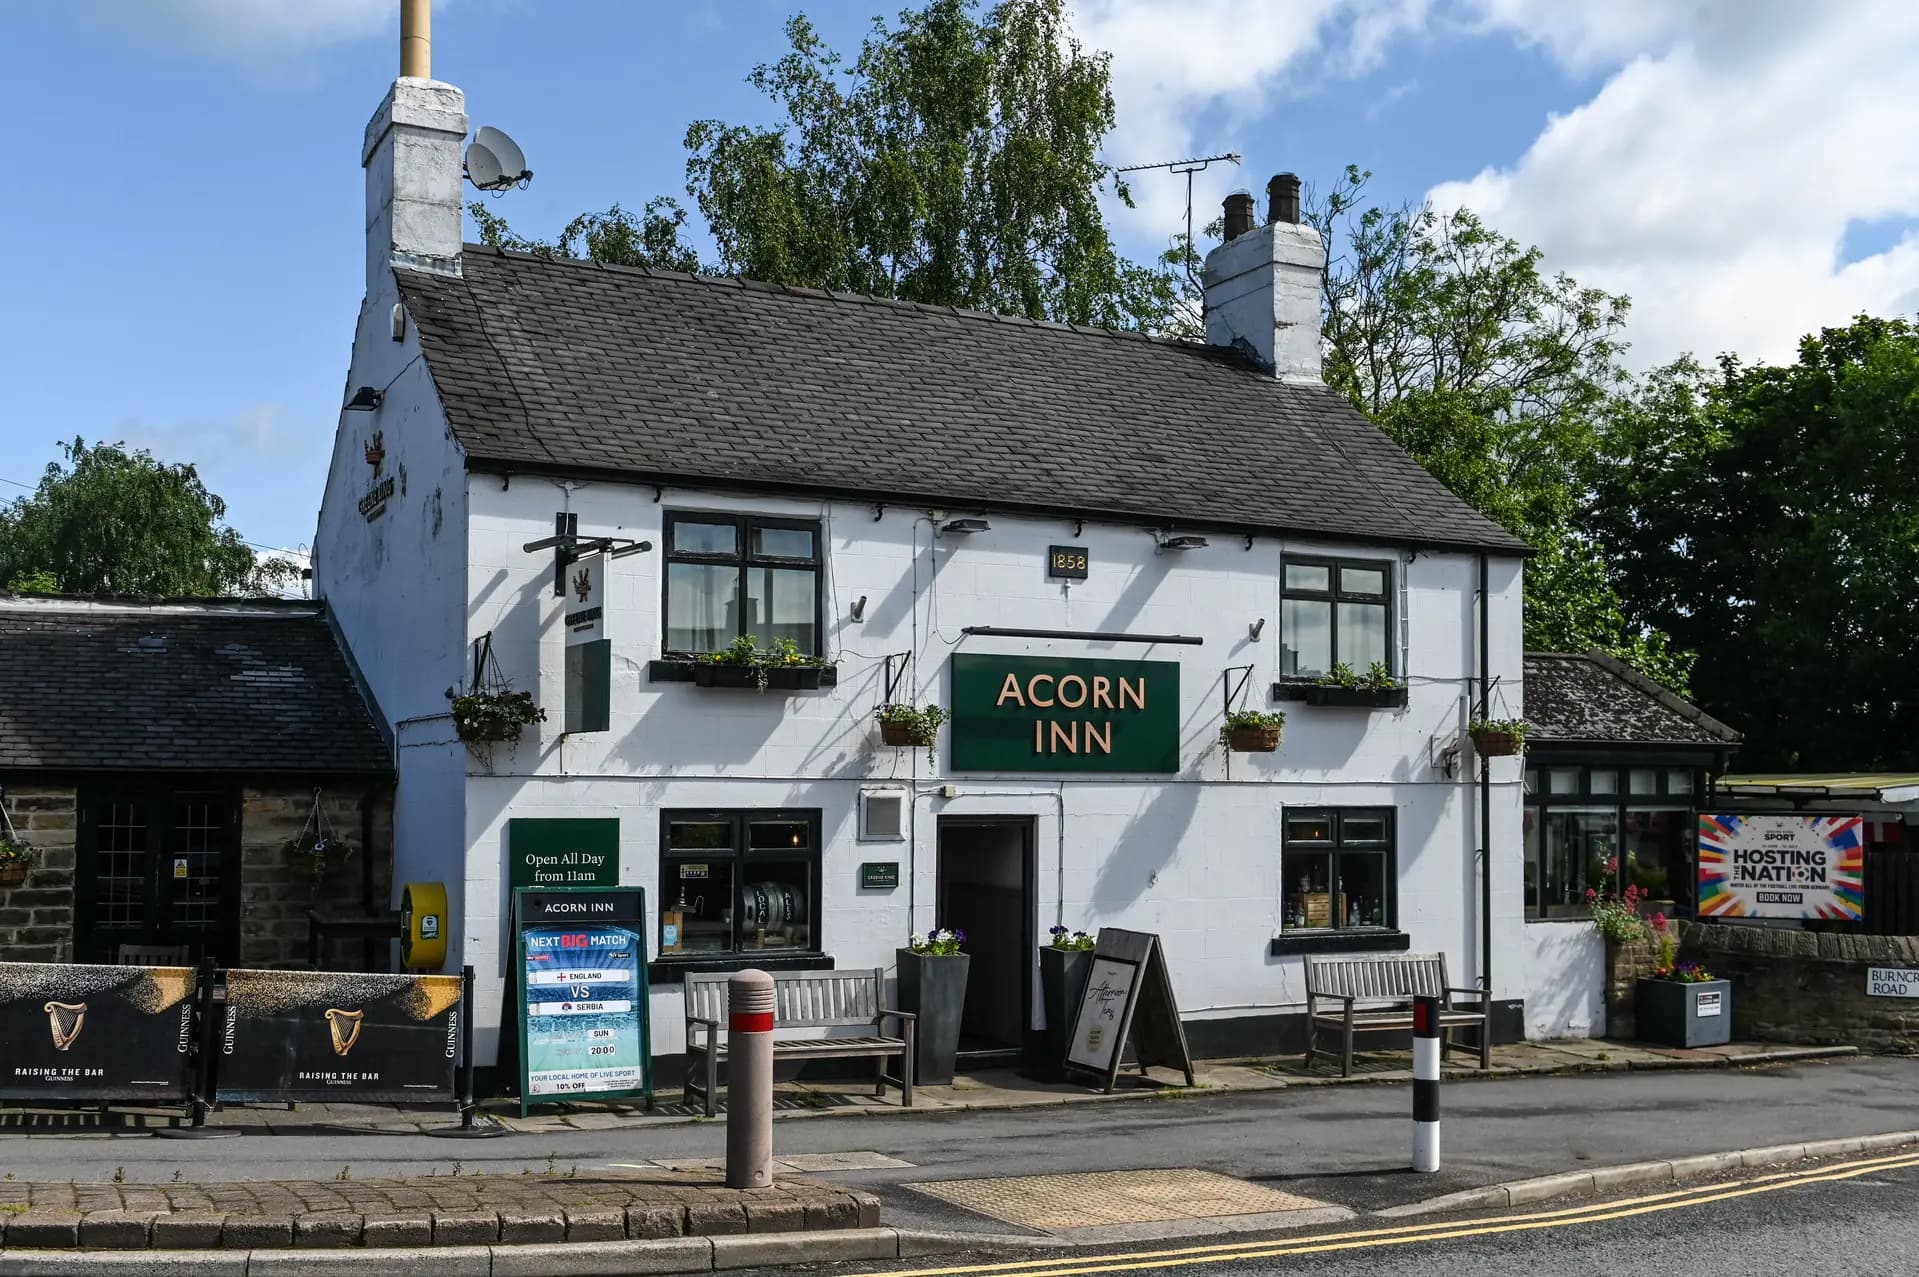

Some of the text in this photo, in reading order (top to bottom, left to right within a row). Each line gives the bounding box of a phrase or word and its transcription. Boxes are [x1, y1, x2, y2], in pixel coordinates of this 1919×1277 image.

[1053, 554, 1086, 570] 1858
[996, 672, 1145, 710] ACORN
[1036, 719, 1111, 754] INN
[1764, 833, 1796, 841] SPORT
[525, 852, 605, 868] Open All Day
[1733, 849, 1827, 866] HOSTING
[534, 869, 596, 882] from 11am
[1740, 865, 1827, 883] NATION
[1759, 892, 1801, 903] BOOK NOW
[544, 903, 614, 913] ACORN INN
[530, 933, 626, 948] NEXT BIG MATCH
[570, 985, 591, 998] VS
[1873, 982, 1908, 995] ROAD
[576, 1003, 604, 1011] SERBIA
[177, 1003, 191, 1053] GUINNESS
[223, 1005, 236, 1055] GUINNESS
[445, 1011, 457, 1058] GUINNESS
[15, 1068, 104, 1076] RAISING THE BAR
[299, 1072, 337, 1080] RAISING
[341, 1072, 358, 1080] THE
[556, 1082, 571, 1090] 10%
